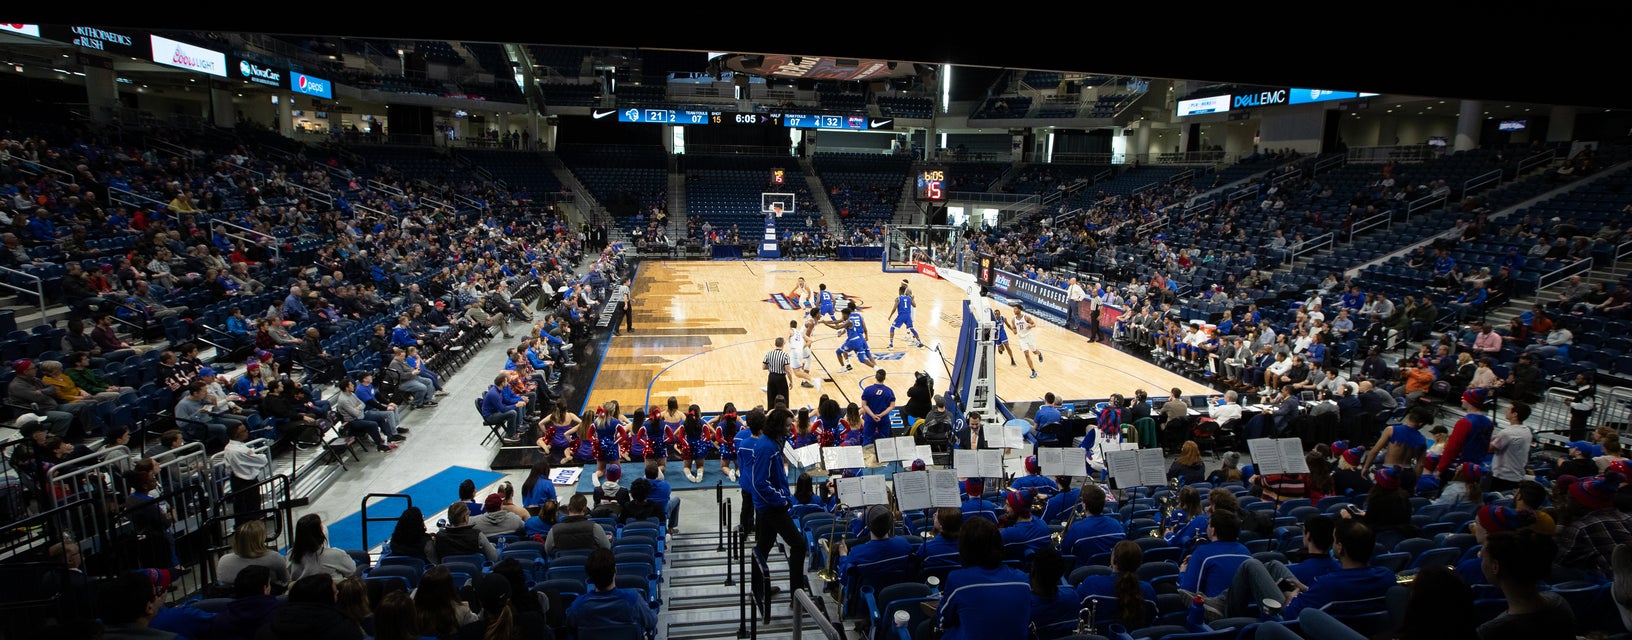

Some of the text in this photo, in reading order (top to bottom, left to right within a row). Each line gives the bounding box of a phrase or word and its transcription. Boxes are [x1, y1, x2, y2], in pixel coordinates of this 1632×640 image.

[71, 26, 132, 46] ORTHOPAEDICS
[80, 36, 104, 50] RUSH
[196, 56, 215, 71] LIGHT
[250, 64, 280, 81] NovaCare
[307, 81, 323, 93] pepsi
[1234, 93, 1260, 108] DELL
[1260, 90, 1286, 105] EMC
[650, 111, 662, 121] 21
[670, 114, 676, 122] 2
[691, 115, 702, 123] 07
[712, 115, 722, 123] 15
[735, 114, 756, 123] 6:05
[826, 117, 838, 126] 32
[790, 118, 800, 126] 07
[814, 119, 820, 127] 4
[924, 170, 944, 181] 6:05
[927, 181, 941, 199] 15
[1015, 279, 1037, 293] PLAYING
[1040, 287, 1069, 304] POSSESSE
